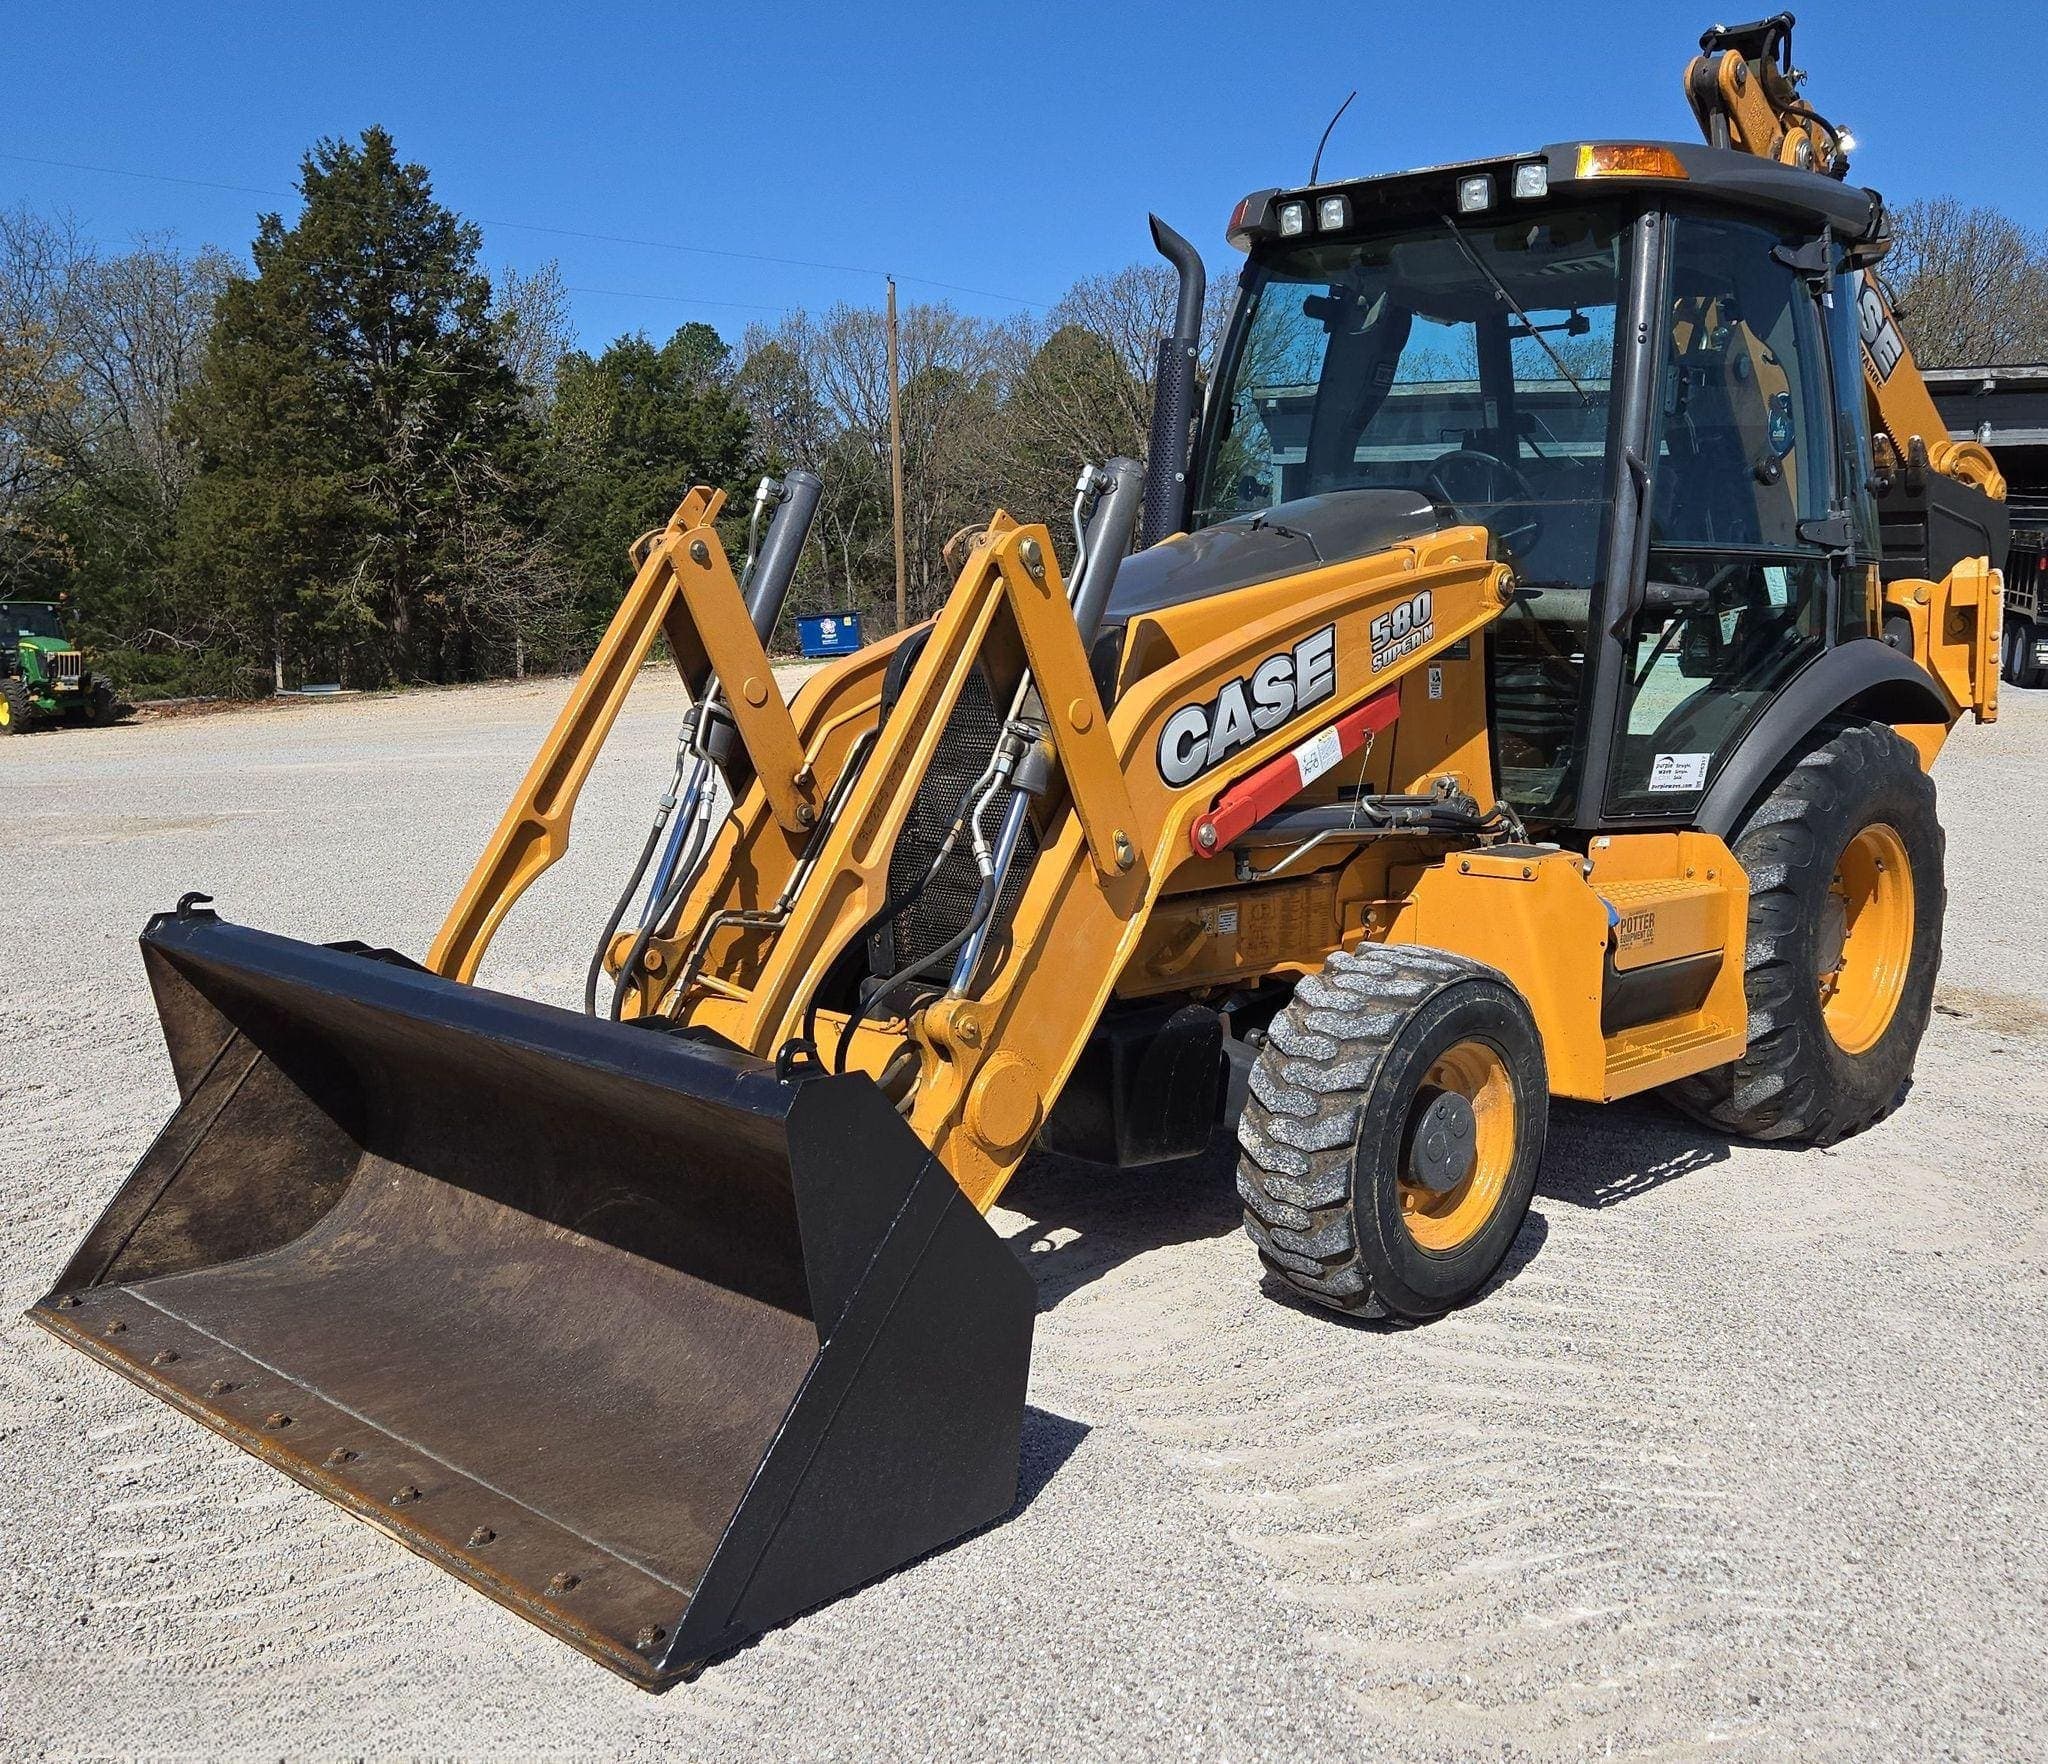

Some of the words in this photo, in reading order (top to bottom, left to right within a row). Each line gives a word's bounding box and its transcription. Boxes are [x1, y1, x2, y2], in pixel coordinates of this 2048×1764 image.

[1857, 272, 1904, 381] SE
[1371, 589, 1433, 650] 580
[1371, 631, 1421, 673] SUPER
[1422, 624, 1434, 643] N
[1157, 624, 1336, 787] CASE
[1619, 929, 1646, 944] EQUIPMENT
[1620, 912, 1655, 934] POTTER
